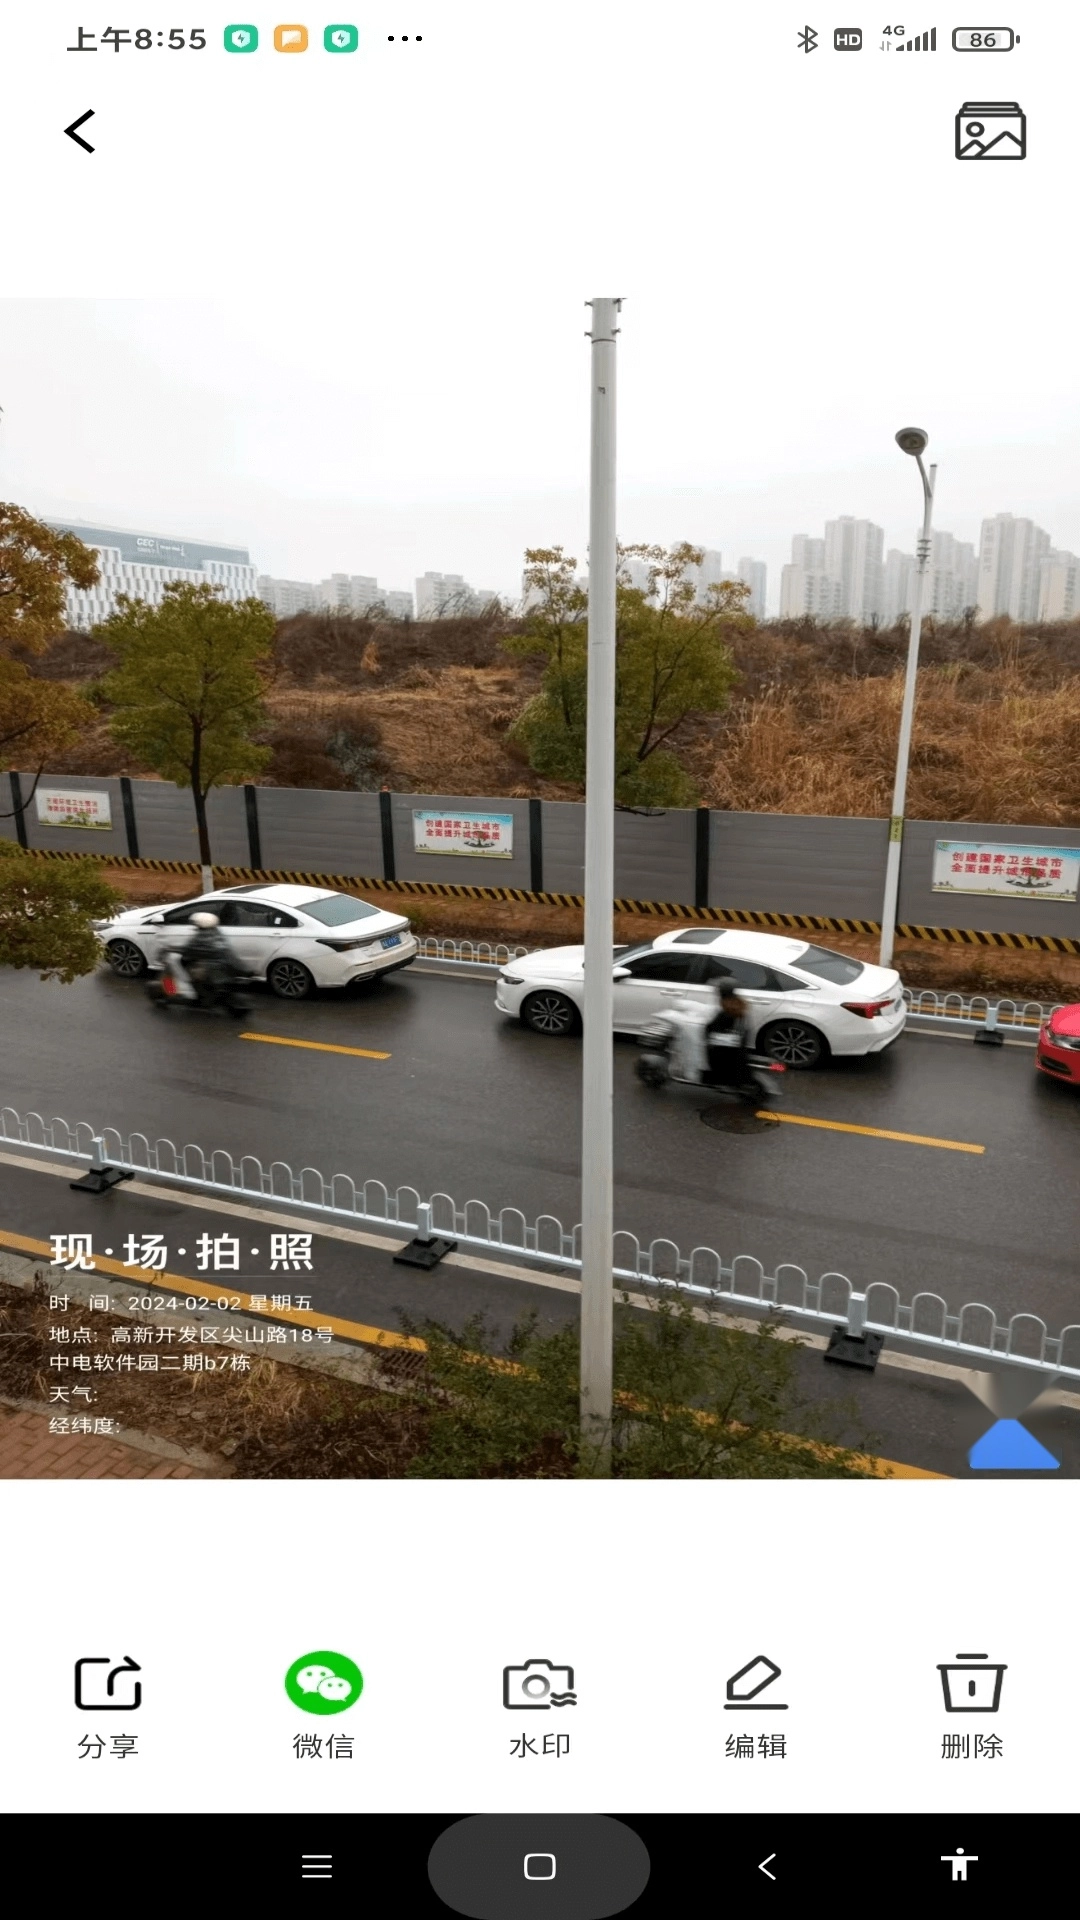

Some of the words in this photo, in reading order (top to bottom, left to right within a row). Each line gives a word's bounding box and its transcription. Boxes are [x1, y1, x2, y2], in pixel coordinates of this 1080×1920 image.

[67, 27, 206, 52] 上午8:55
[836, 34, 861, 46] HD
[882, 25, 905, 36] 4G
[969, 33, 997, 47] 86
[136, 538, 155, 547] CEC
[425, 819, 500, 831] 创建国家卫生城市
[951, 852, 1063, 867] 创建国家卫生城市
[77, 1733, 139, 1759] 分享
[292, 1733, 355, 1759] 微信
[509, 1732, 571, 1759] 水印
[725, 1733, 787, 1759] 编辑
[941, 1733, 1003, 1759] 删除
